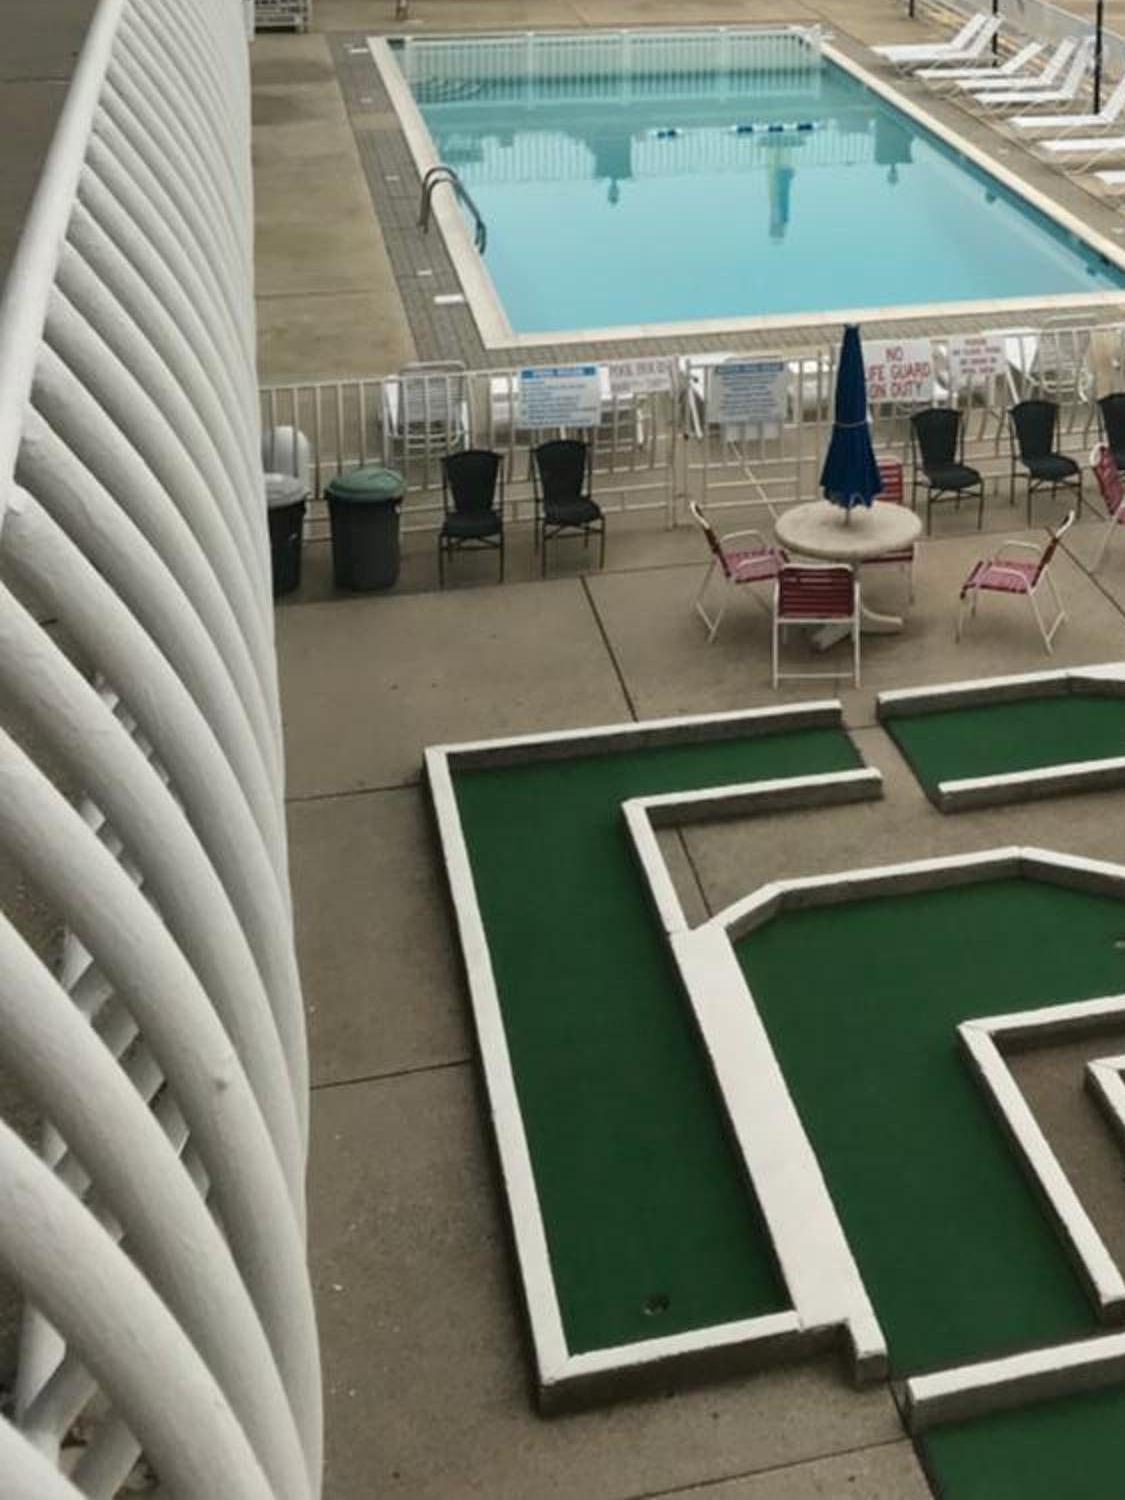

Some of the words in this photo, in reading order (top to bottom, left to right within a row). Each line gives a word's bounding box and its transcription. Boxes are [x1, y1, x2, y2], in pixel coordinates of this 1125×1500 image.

[885, 346, 904, 362] NO
[890, 361, 929, 380] GUARD
[869, 381, 887, 399] ON
[890, 380, 924, 398] DUTY
